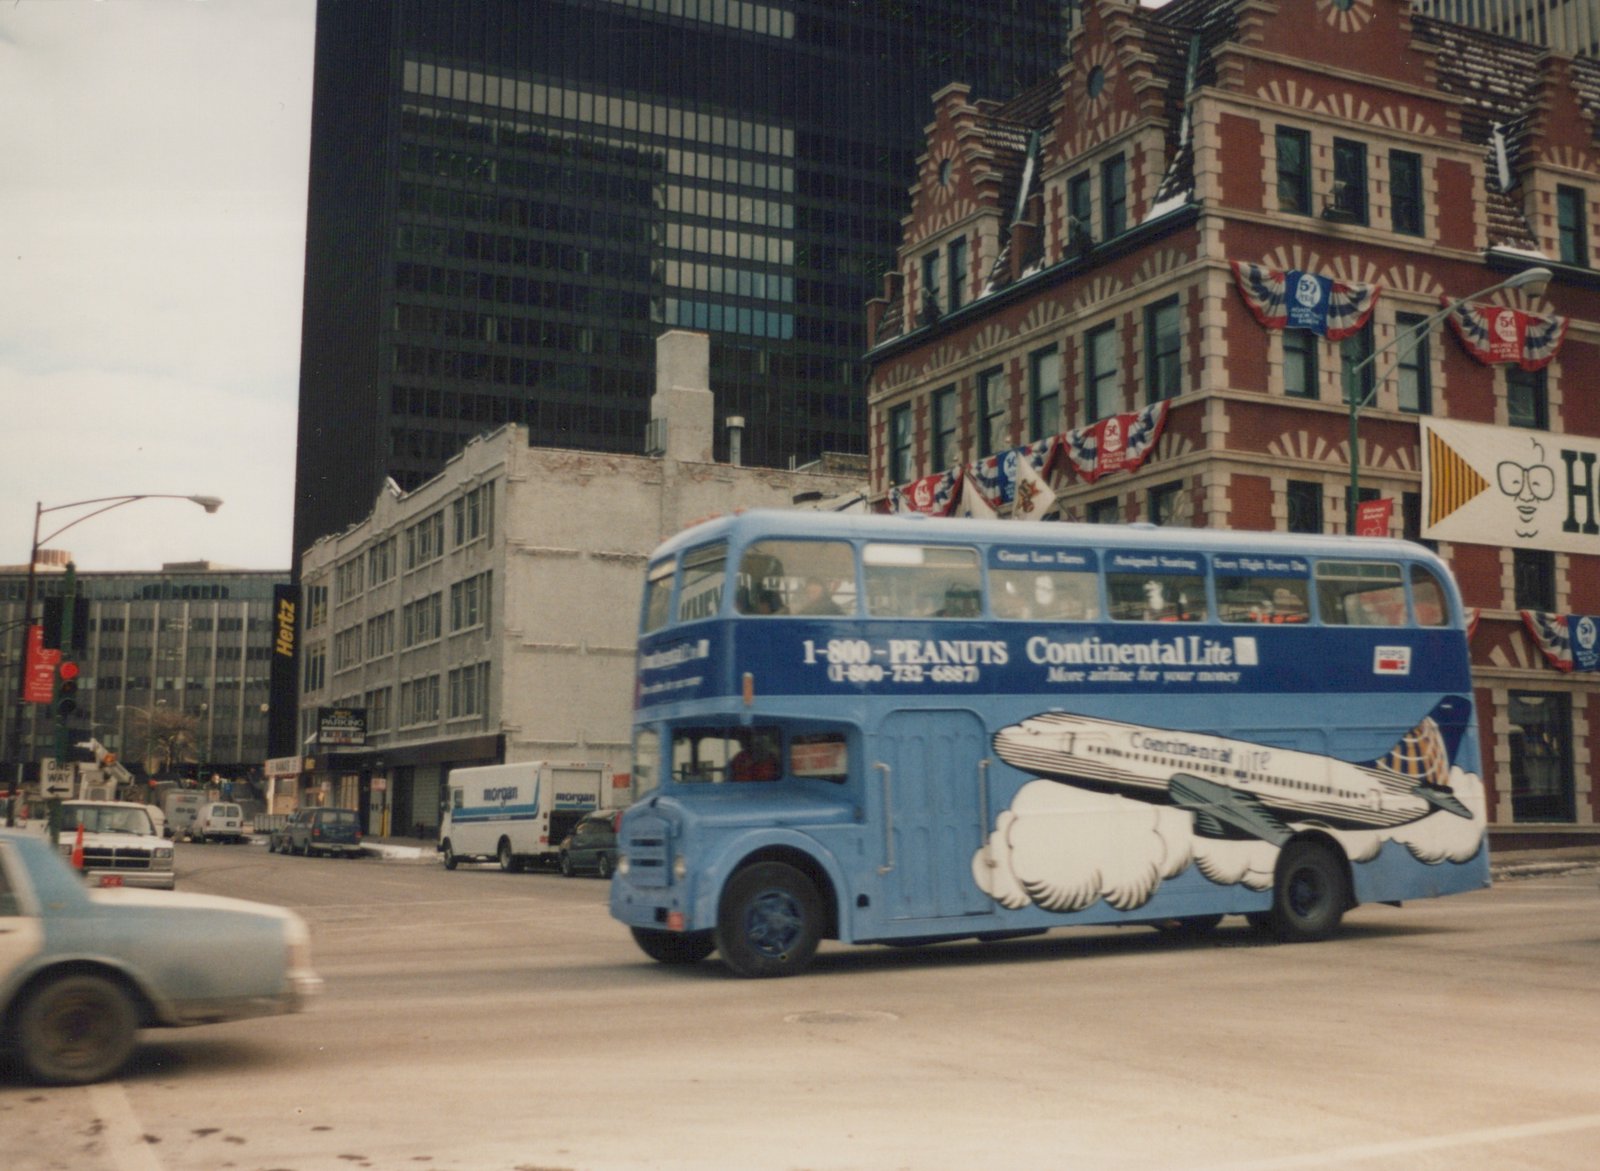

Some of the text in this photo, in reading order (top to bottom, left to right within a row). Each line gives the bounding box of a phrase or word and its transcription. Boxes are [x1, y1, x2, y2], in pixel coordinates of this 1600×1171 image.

[1560, 448, 1600, 535] H
[276, 598, 295, 657] Hertz
[1026, 636, 1233, 665] Continental Lite
[1046, 666, 1242, 684] More airline for your money
[321, 718, 364, 727] PARKING
[47, 760, 72, 771] ONE
[47, 772, 72, 783] WAY
[483, 786, 518, 808] morgan
[555, 792, 596, 804] morgan
